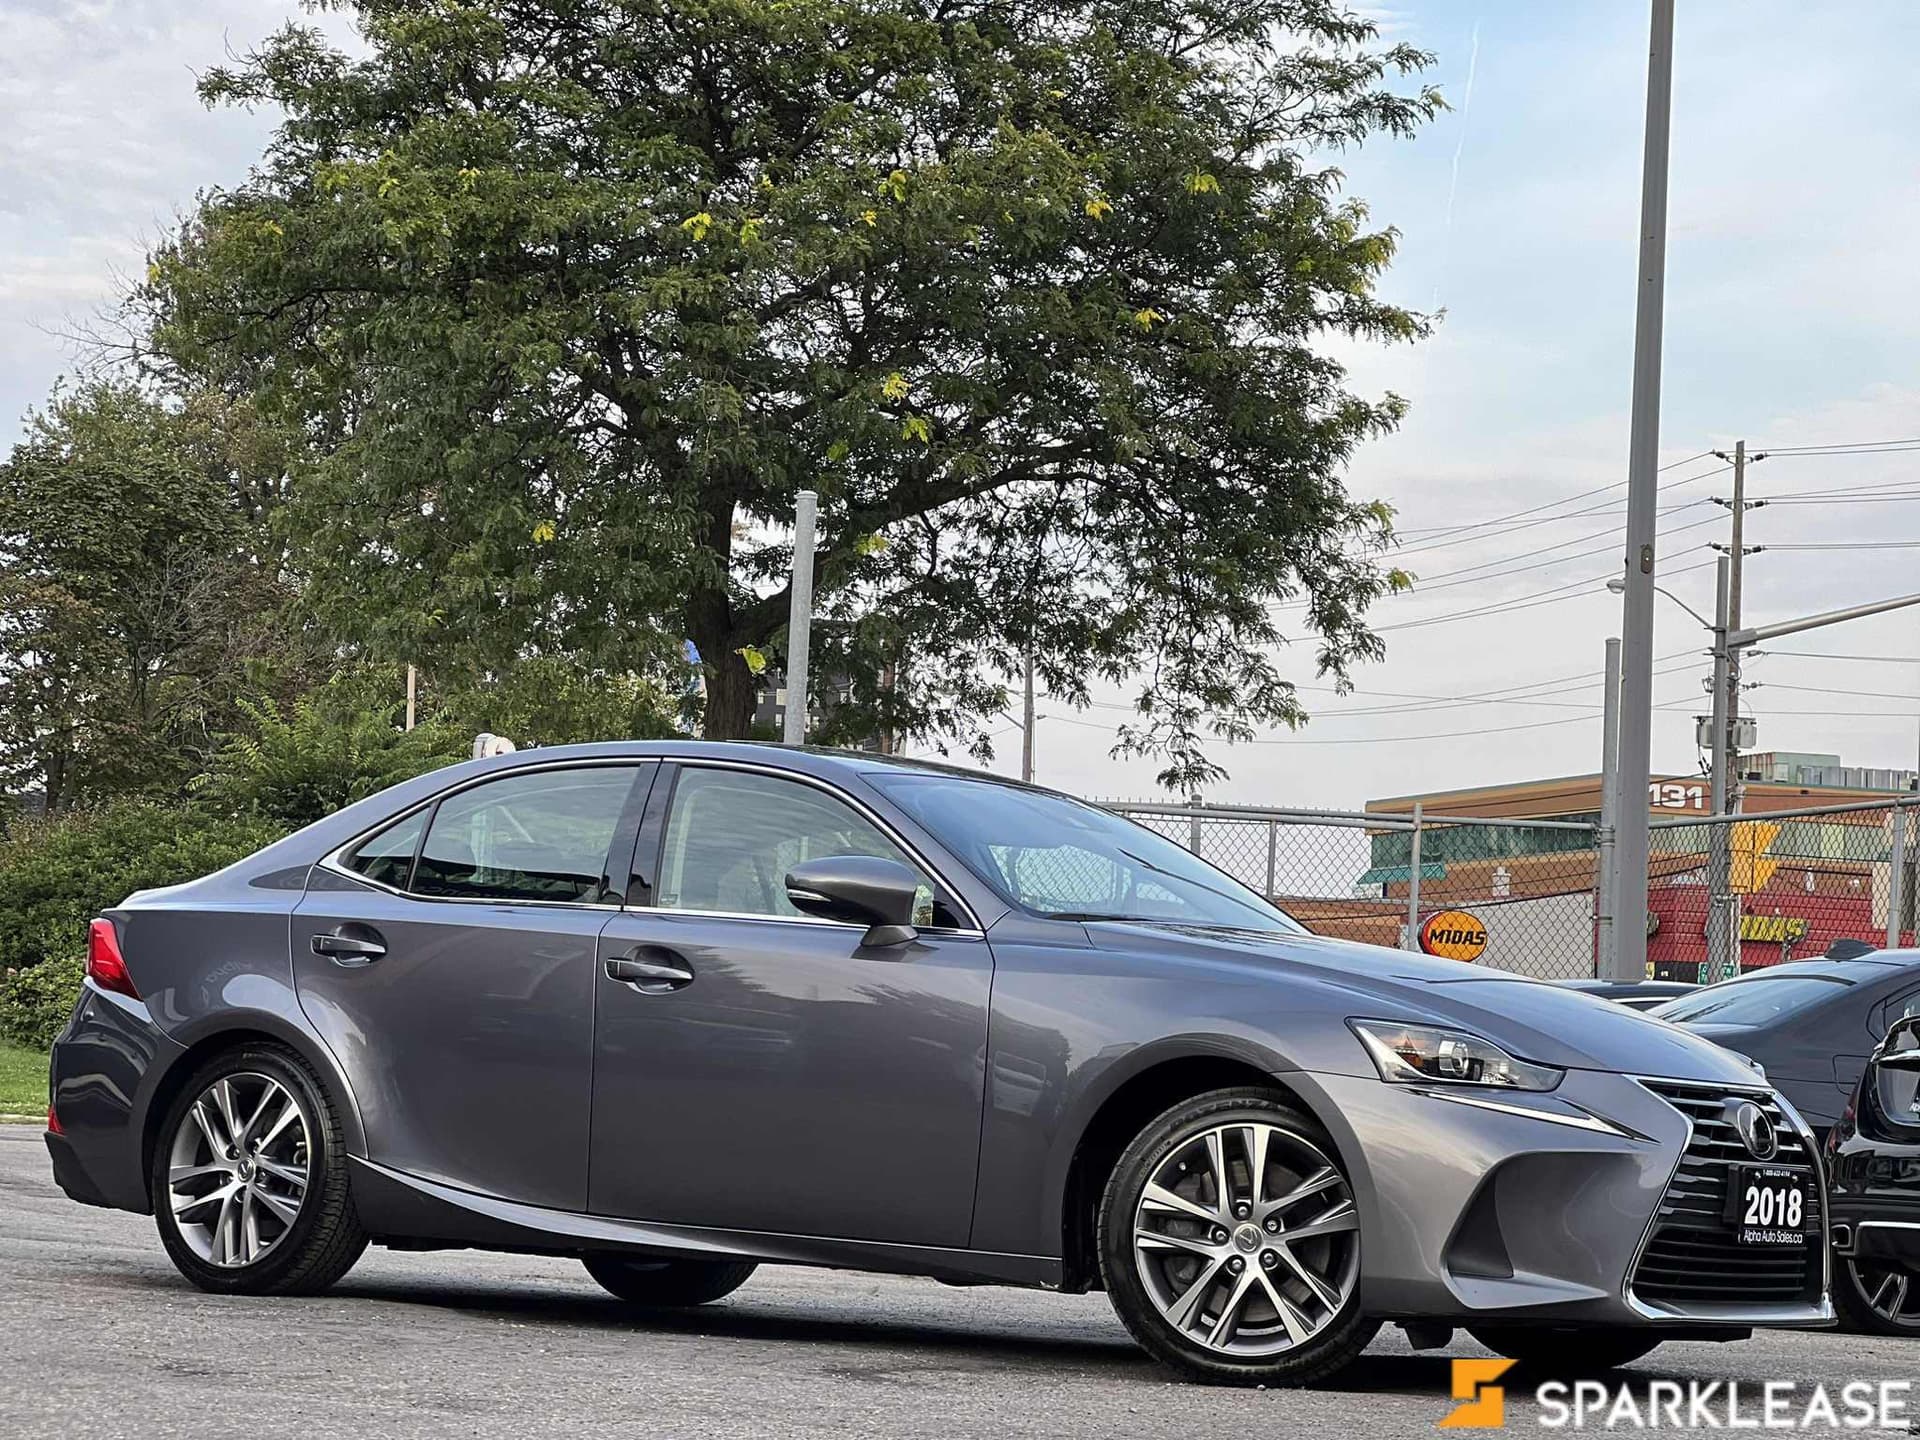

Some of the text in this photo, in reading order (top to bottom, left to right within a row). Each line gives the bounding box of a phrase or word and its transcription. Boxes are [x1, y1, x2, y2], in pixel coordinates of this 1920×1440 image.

[1649, 783, 1703, 809] 131
[1429, 928, 1488, 946] MIDAS
[1744, 1186, 1802, 1227] 2018
[1743, 1229, 1761, 1244] Alpha
[1762, 1229, 1776, 1243] Auto
